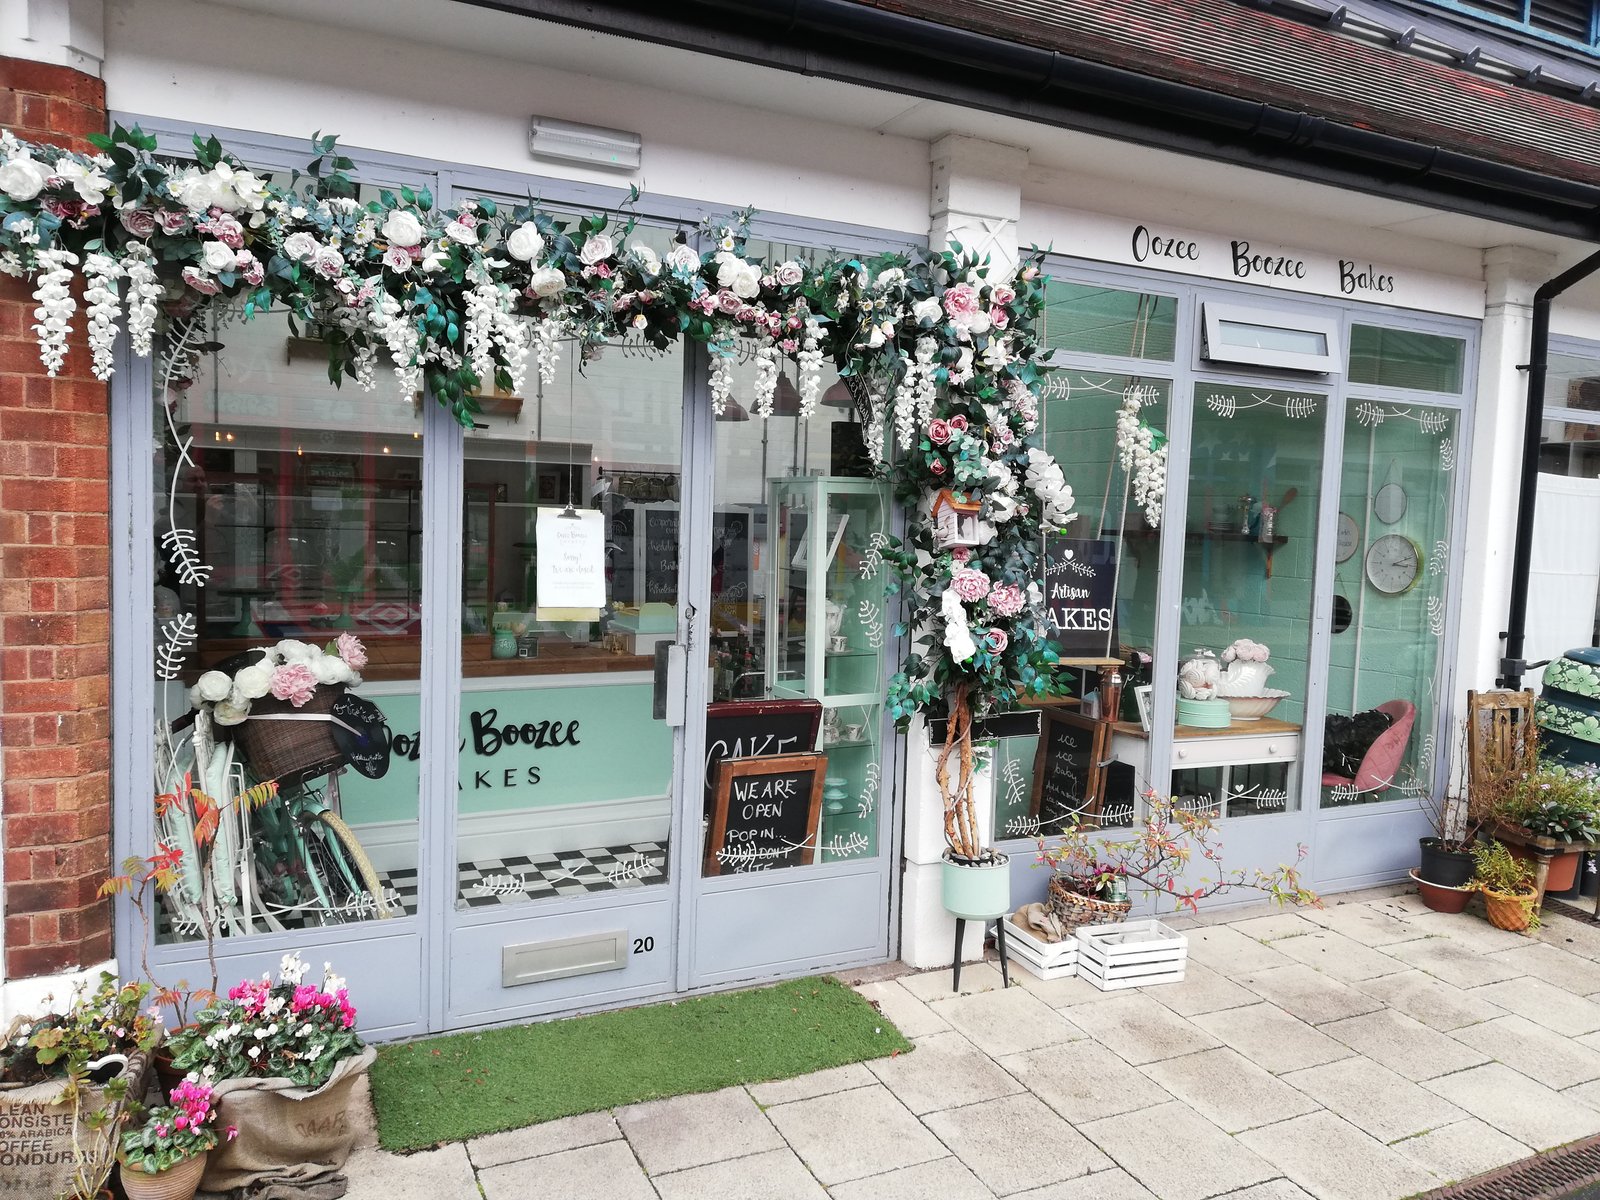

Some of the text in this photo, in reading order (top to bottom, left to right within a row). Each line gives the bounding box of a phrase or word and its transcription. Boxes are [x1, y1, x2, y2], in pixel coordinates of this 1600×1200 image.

[1132, 225, 1394, 294] Oozee Boozee Bakes
[1050, 582, 1090, 600] Artisan
[1047, 607, 1111, 631] AKES
[470, 708, 581, 756] Boozee
[734, 778, 797, 802] WE ARE
[742, 801, 783, 821] OPEN
[726, 829, 758, 843] POP
[633, 936, 655, 954] 20
[0, 1103, 47, 1117] LEAN
[20, 1127, 73, 1139] ARABICA
[0, 1139, 53, 1153] OFFEE
